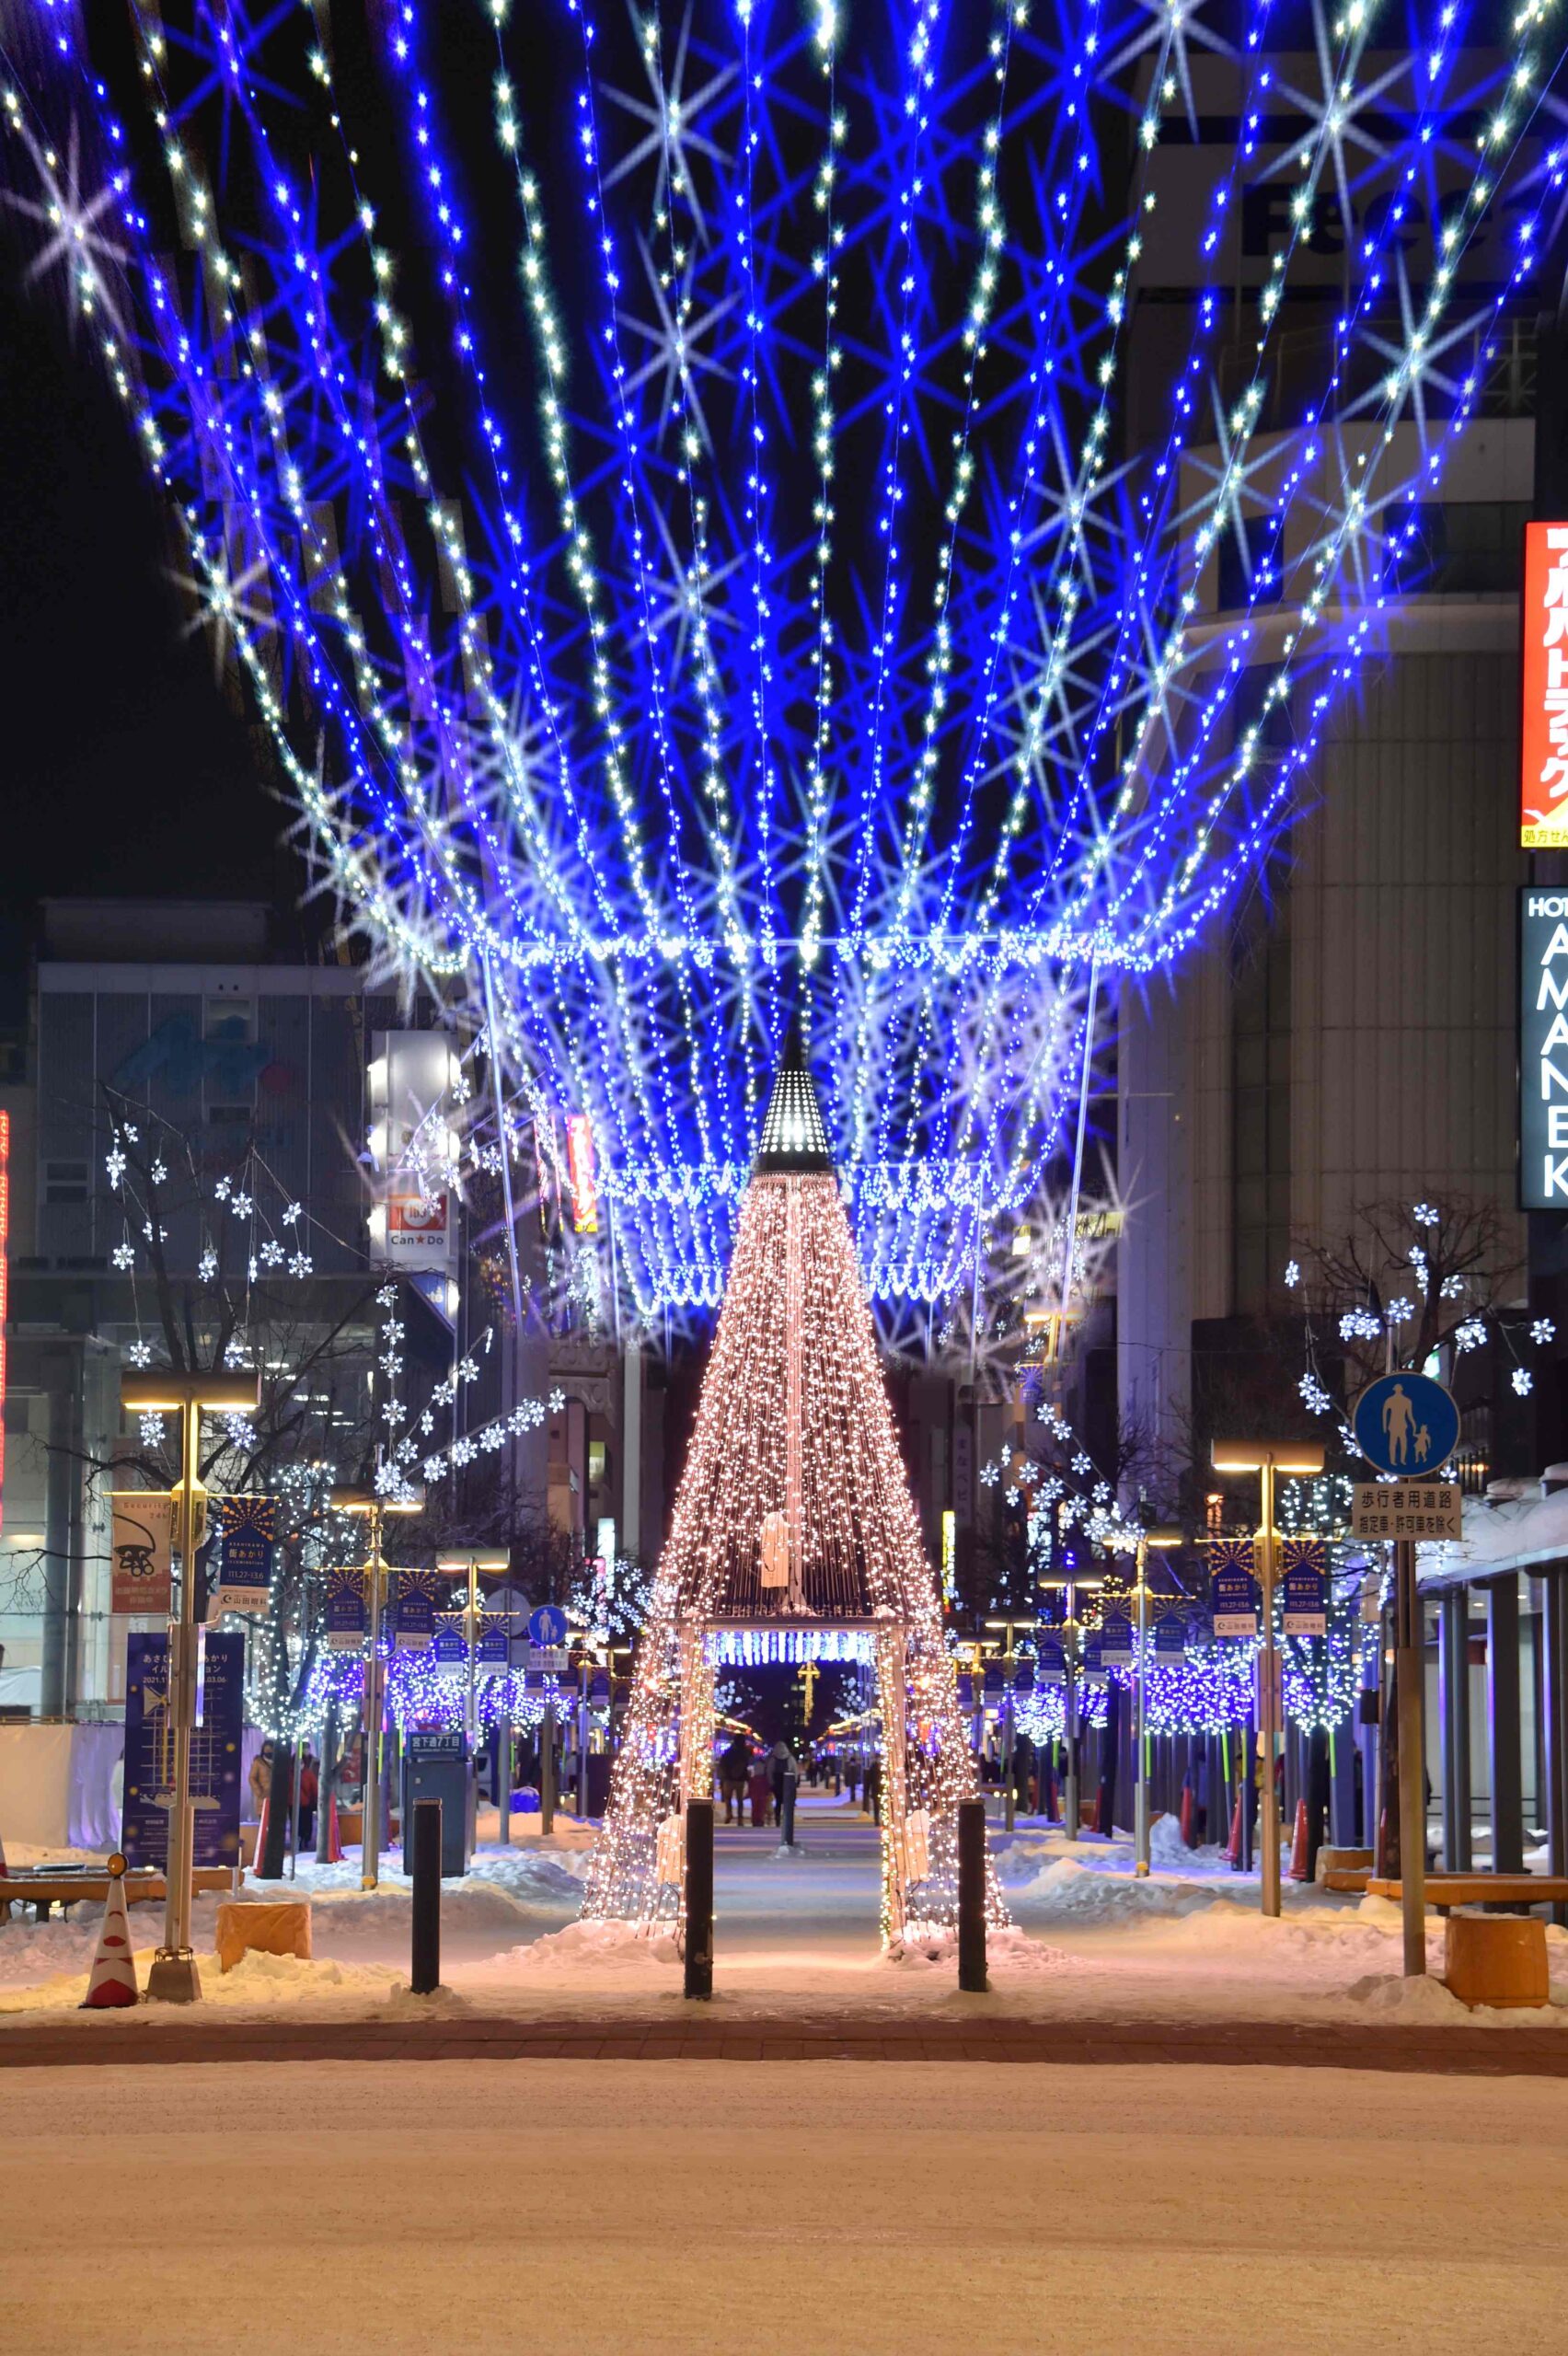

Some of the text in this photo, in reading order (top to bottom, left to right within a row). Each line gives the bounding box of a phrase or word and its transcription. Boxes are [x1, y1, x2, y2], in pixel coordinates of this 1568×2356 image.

[1361, 1490, 1452, 1509] 歩行者用道路
[1359, 1515, 1456, 1533] 指定車・許可車を除く
[228, 1548, 265, 1559] 街あかり
